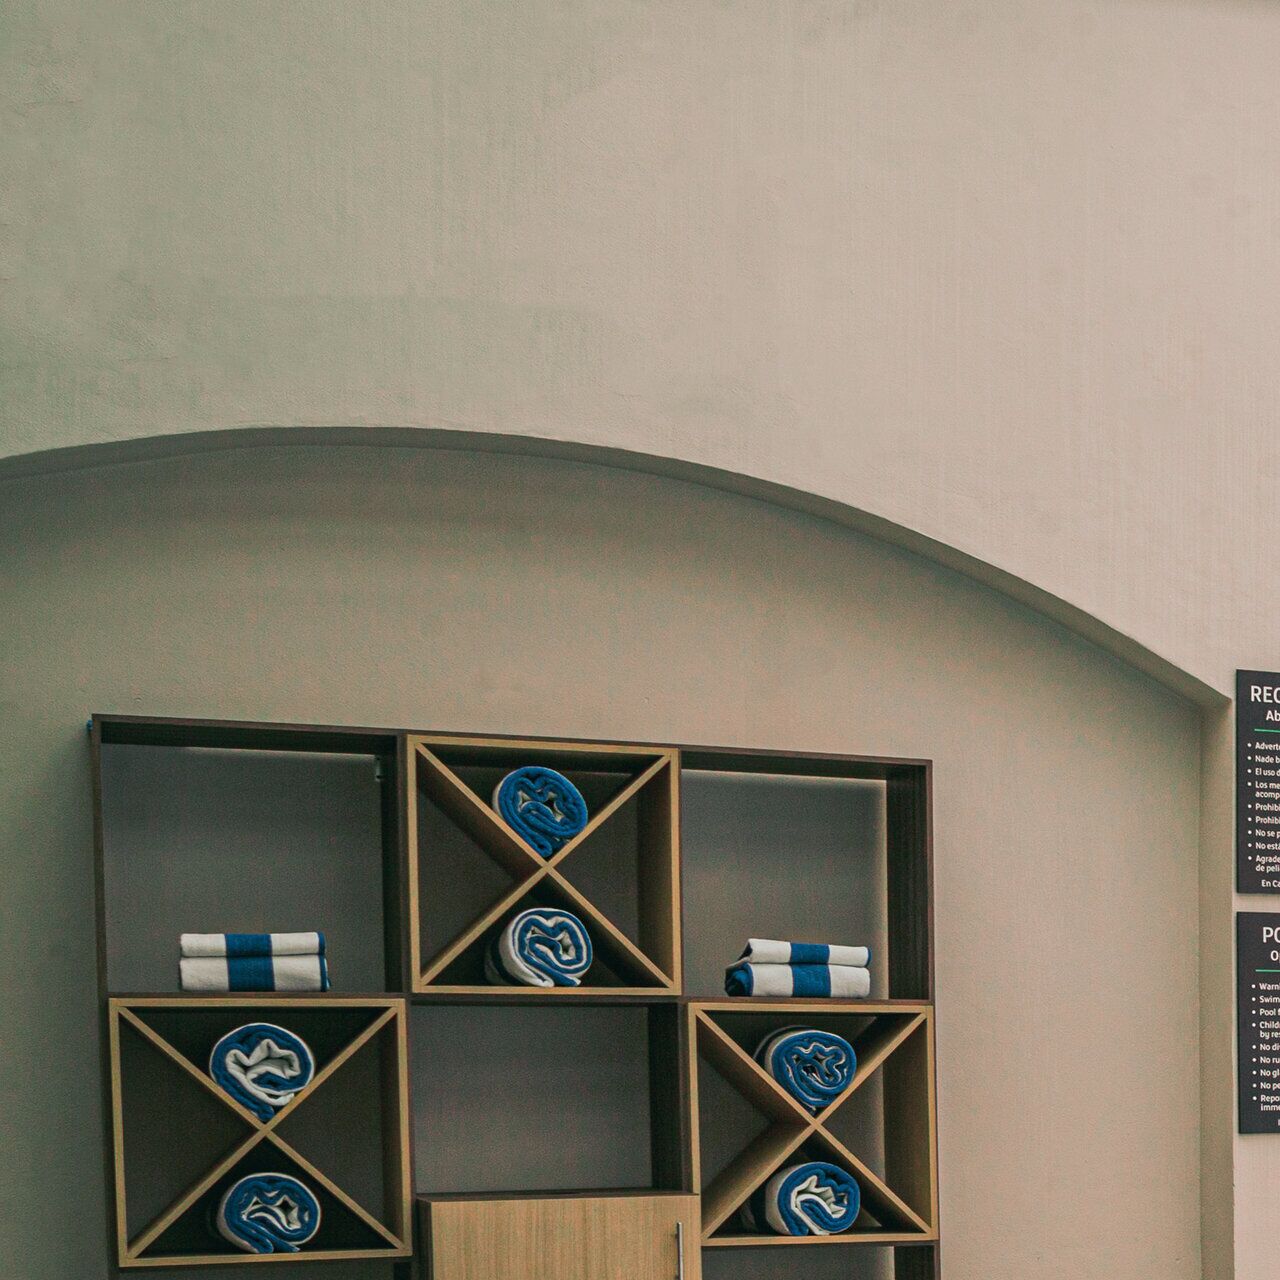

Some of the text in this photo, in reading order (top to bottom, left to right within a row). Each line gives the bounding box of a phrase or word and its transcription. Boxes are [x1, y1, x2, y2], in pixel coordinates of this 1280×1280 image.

[1255, 755, 1274, 763] Nade
[1255, 780, 1268, 789] Los
[1255, 828, 1266, 837] No
[1255, 841, 1266, 850] No
[1255, 863, 1265, 872] de
[1261, 879, 1271, 887] En
[1259, 995, 1280, 1003] Swim
[1259, 1008, 1276, 1016] Pool
[1260, 1030, 1269, 1040] by
[1259, 1043, 1271, 1051] No
[1260, 1081, 1271, 1089] No
